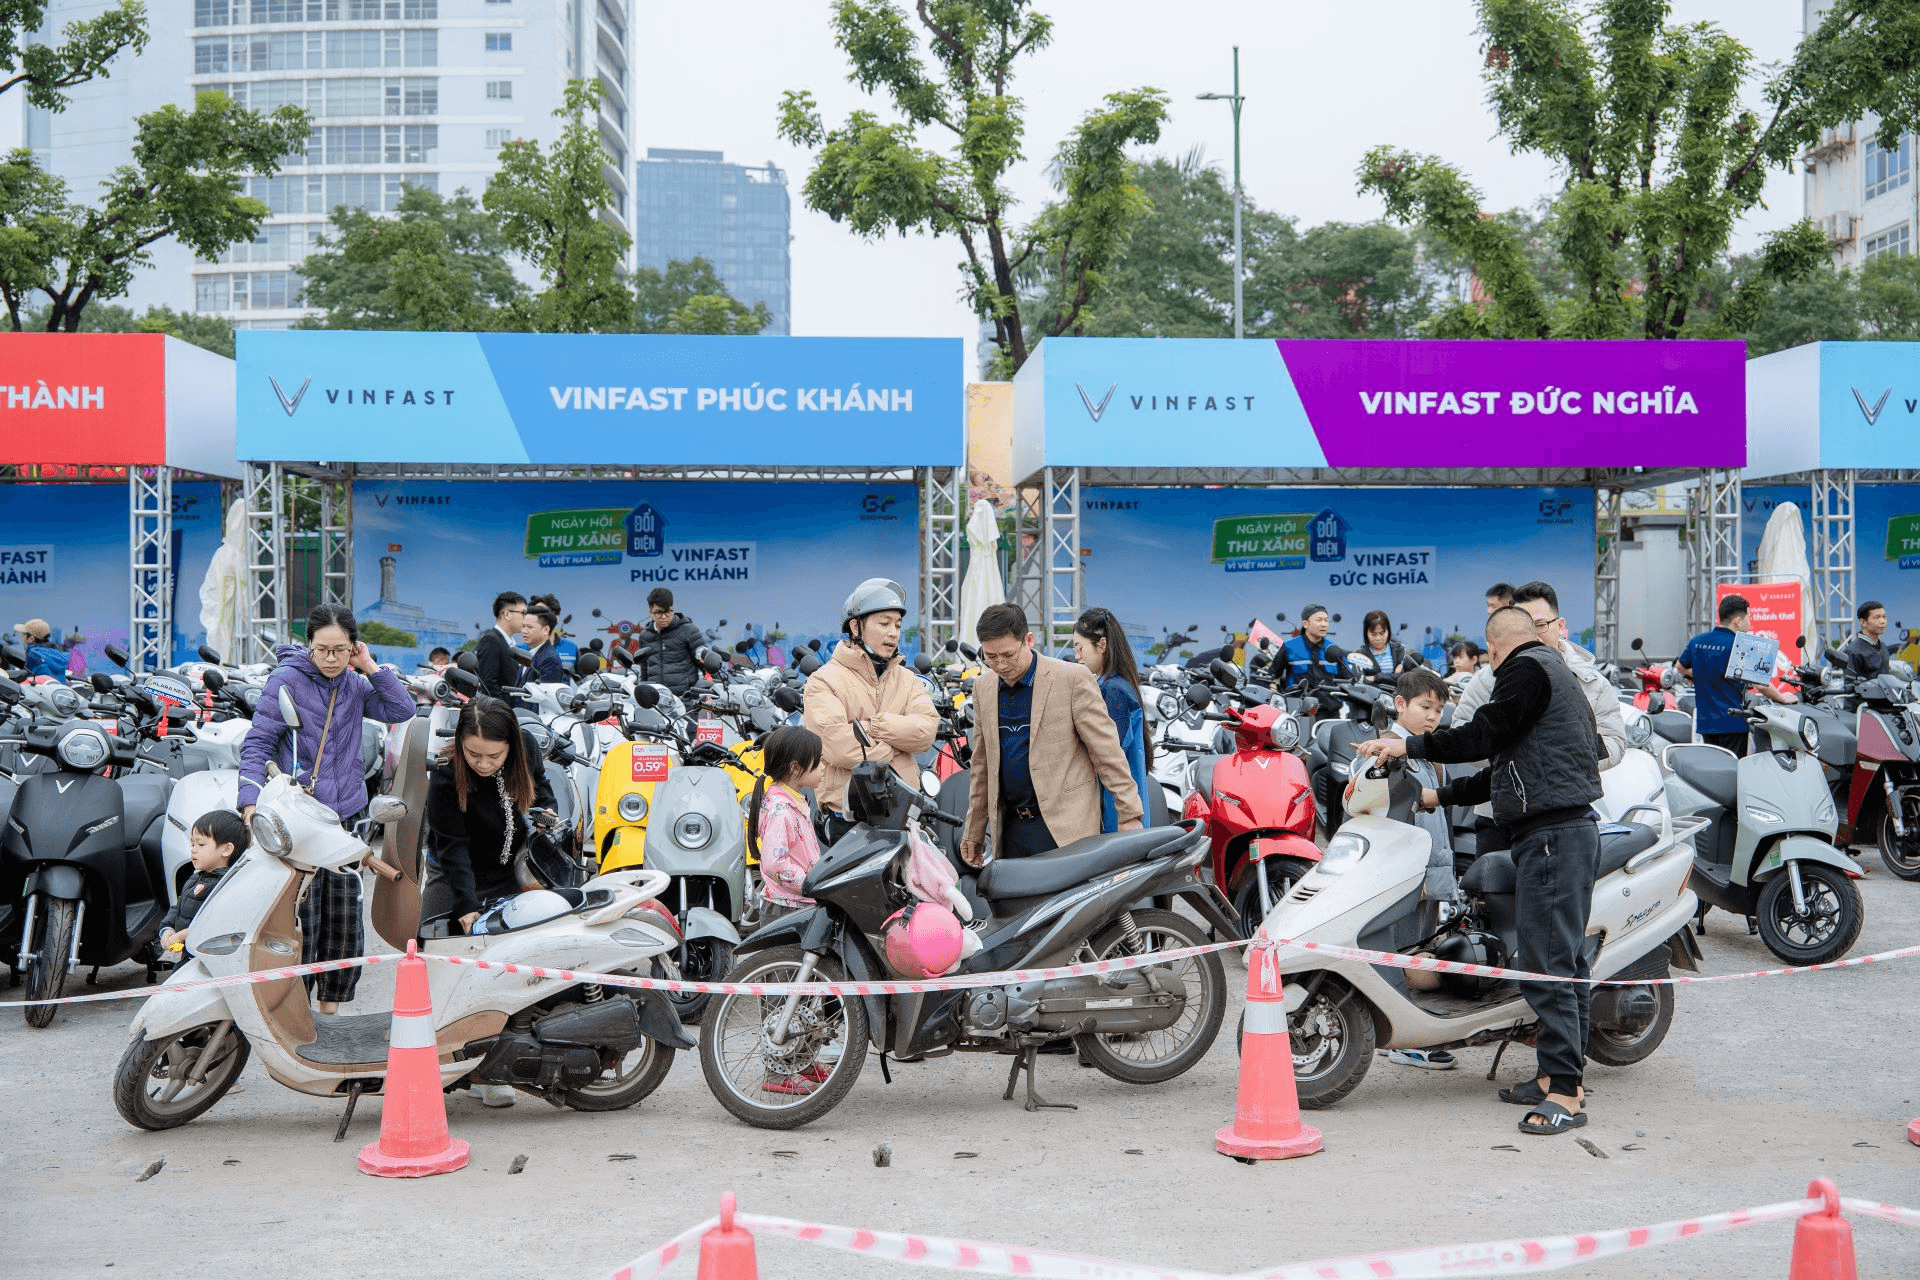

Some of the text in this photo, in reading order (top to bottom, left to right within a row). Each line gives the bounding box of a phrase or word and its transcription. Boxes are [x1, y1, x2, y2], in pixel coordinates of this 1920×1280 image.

[326, 389, 455, 405] VINFAST
[549, 382, 913, 412] VINFAST PHÚC KHÁNH
[1131, 395, 1255, 411] VINFAST
[1359, 386, 1699, 415] VINFAST ĐỨC NGHĨA
[396, 495, 451, 505] VINFAST
[1086, 500, 1139, 510] VINFAST
[551, 514, 613, 530] NGÀY HỘI
[634, 508, 655, 532] ĐỔI
[1236, 520, 1297, 535] NGÀY HỘI
[1317, 513, 1337, 538] ĐỔI
[541, 530, 622, 547] THU XĂNG
[634, 534, 656, 553] ĐIỆN
[1227, 536, 1305, 552] THU XĂNG
[672, 547, 750, 562] VINFAST
[1317, 540, 1338, 557] ĐIỆN
[552, 556, 571, 565] VIỆT
[572, 556, 593, 564] NAM
[1237, 560, 1256, 570] VIỆT
[1257, 561, 1277, 569] NAM
[1353, 552, 1430, 567] VINFAST
[630, 564, 749, 582] PHÚC KHÁNH
[1328, 568, 1429, 586] ĐỨC NGHĨA
[1694, 643, 1726, 652] VINFAST
